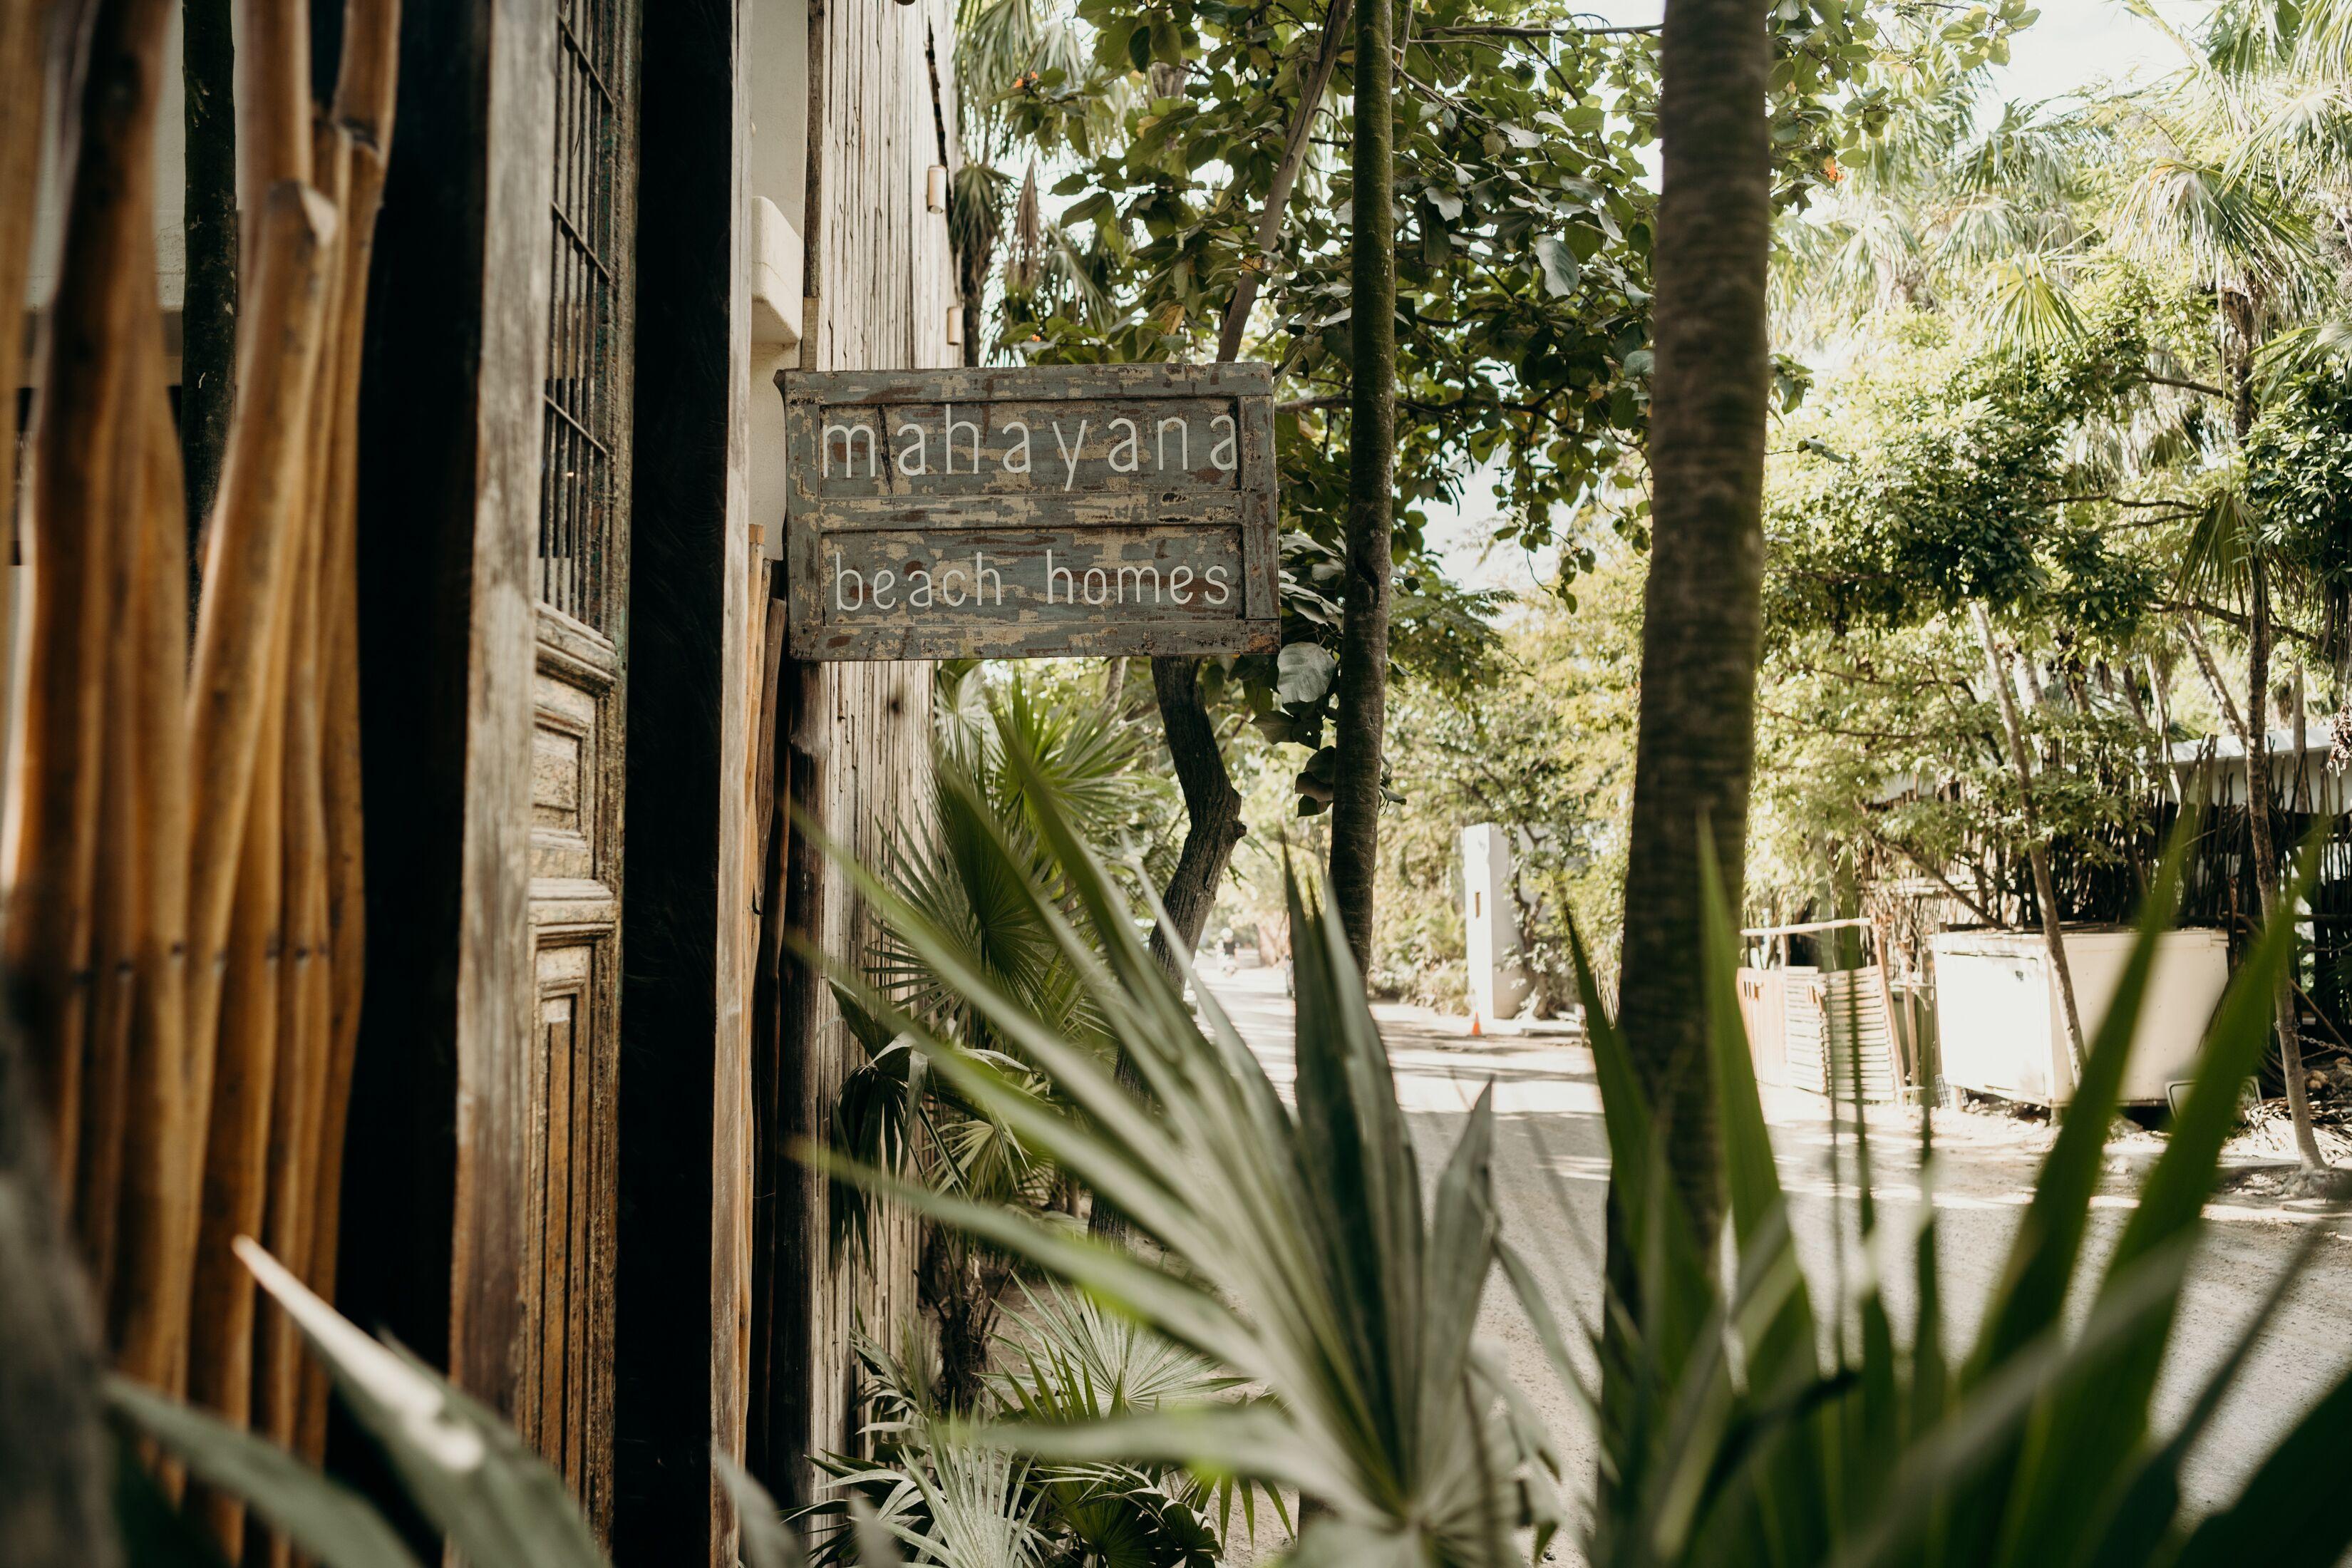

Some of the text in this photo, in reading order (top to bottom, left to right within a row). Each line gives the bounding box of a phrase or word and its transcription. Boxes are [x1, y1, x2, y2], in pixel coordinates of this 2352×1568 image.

[822, 403, 1238, 492] mahayana
[836, 549, 1229, 611] beach homes
